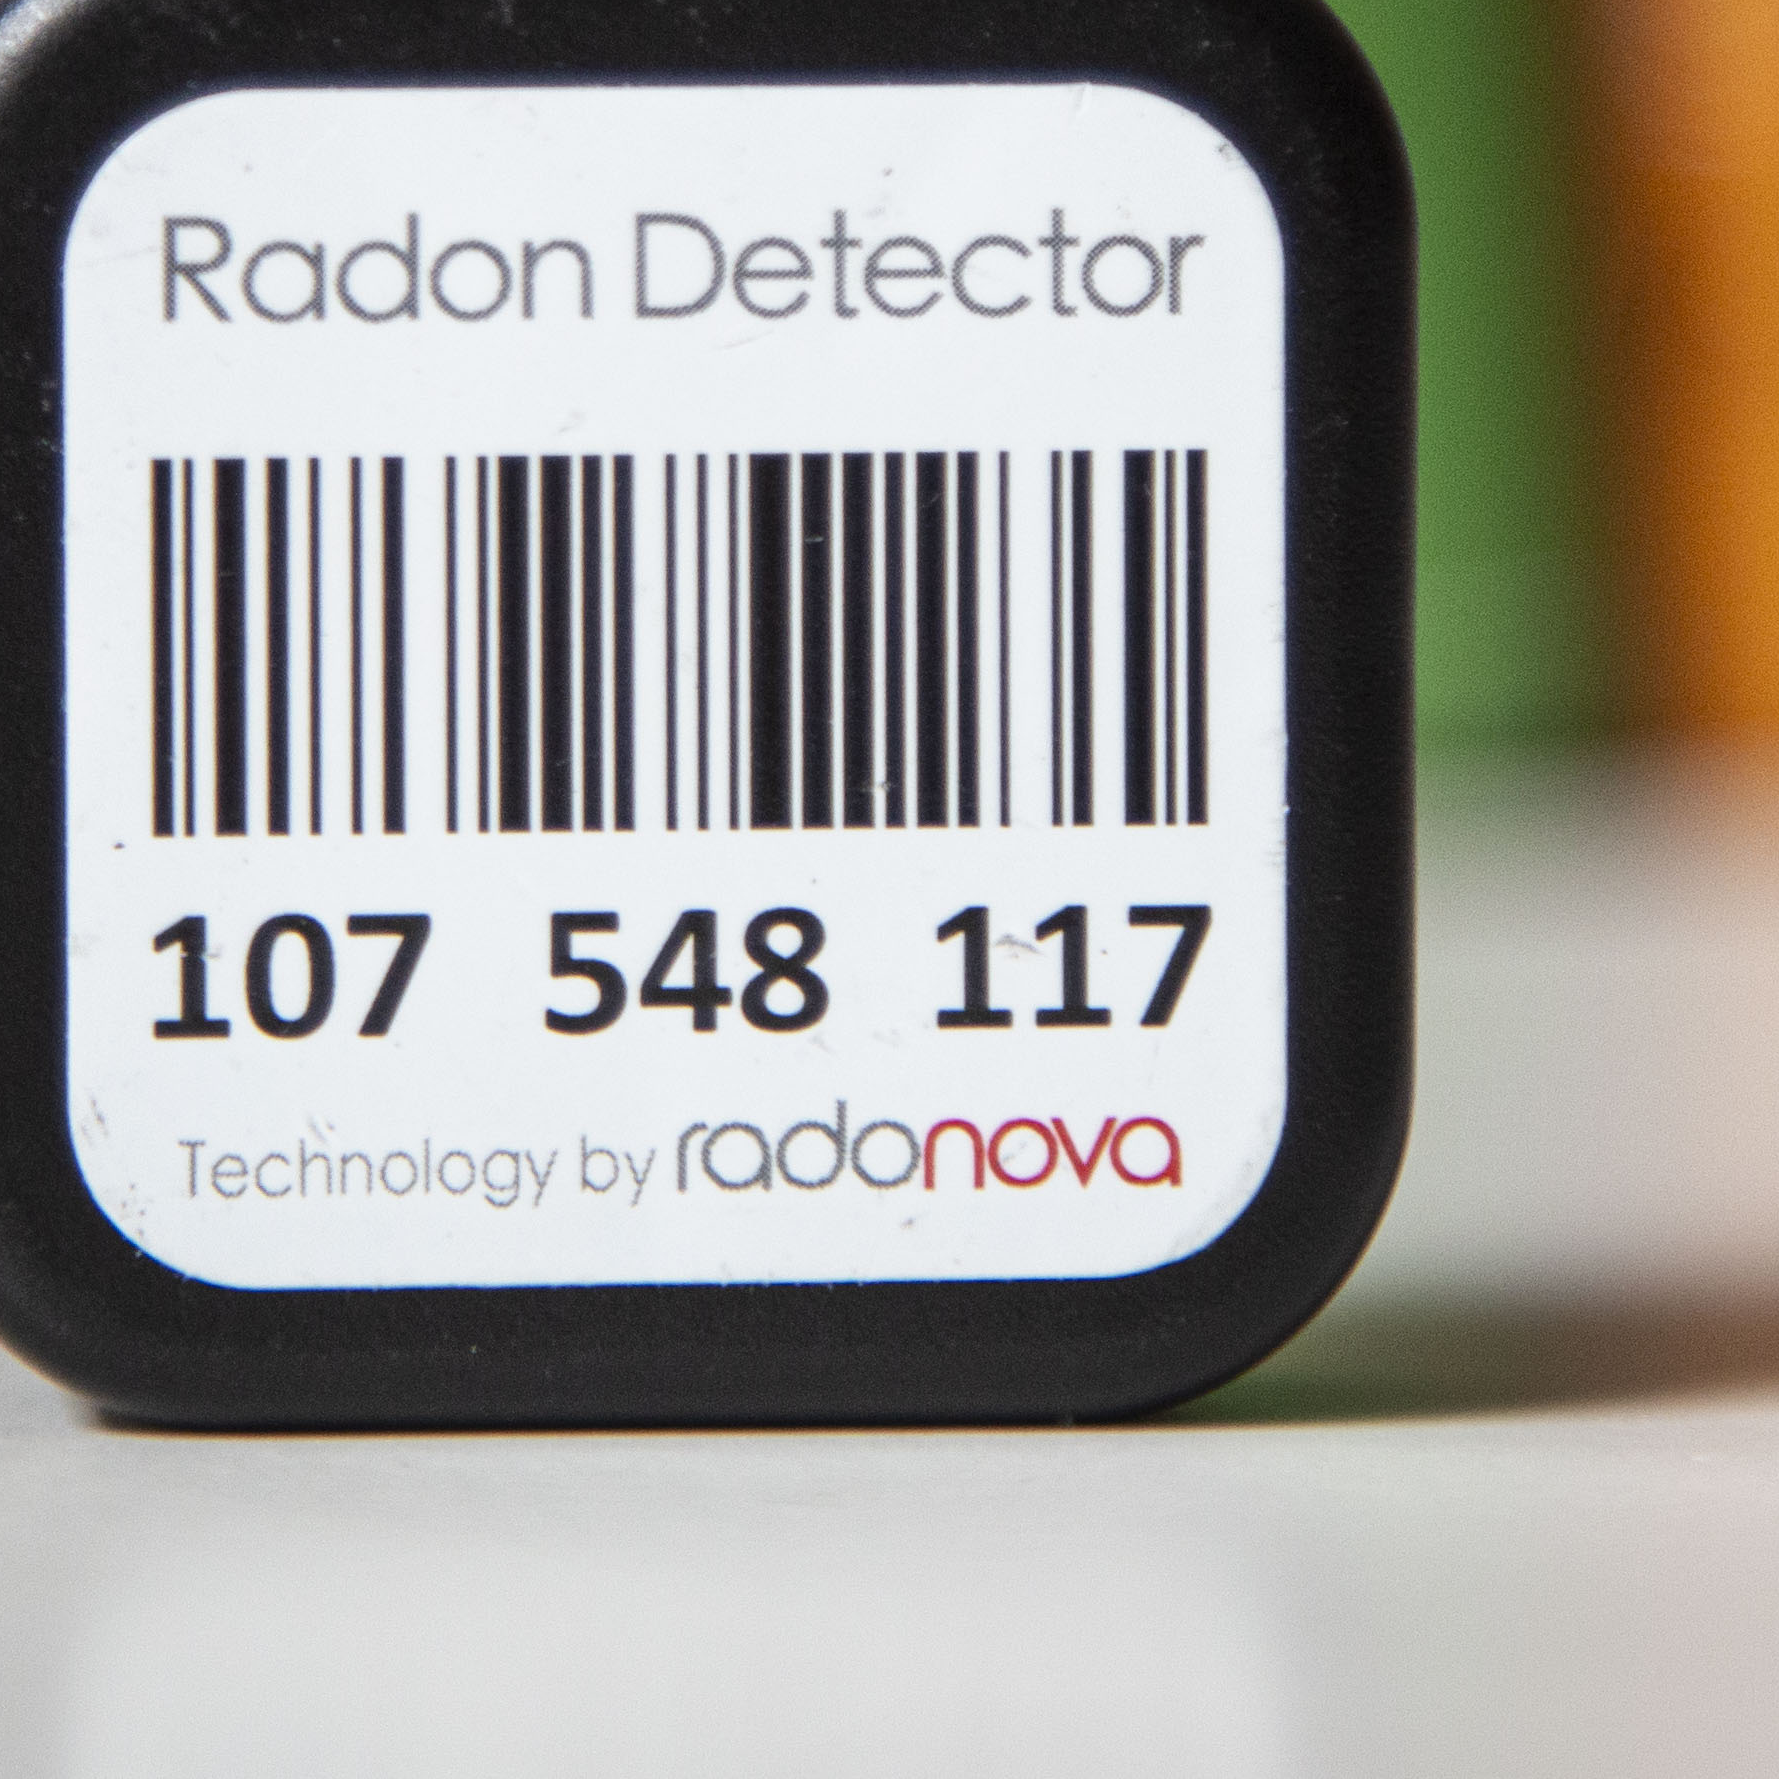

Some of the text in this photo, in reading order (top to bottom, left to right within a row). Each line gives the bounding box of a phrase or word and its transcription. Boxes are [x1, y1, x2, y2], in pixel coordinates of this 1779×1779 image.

[161, 207, 1206, 324] Radon Detector
[150, 902, 1214, 1041] 107 548 117
[178, 1098, 1184, 1209] Technology by radonova
